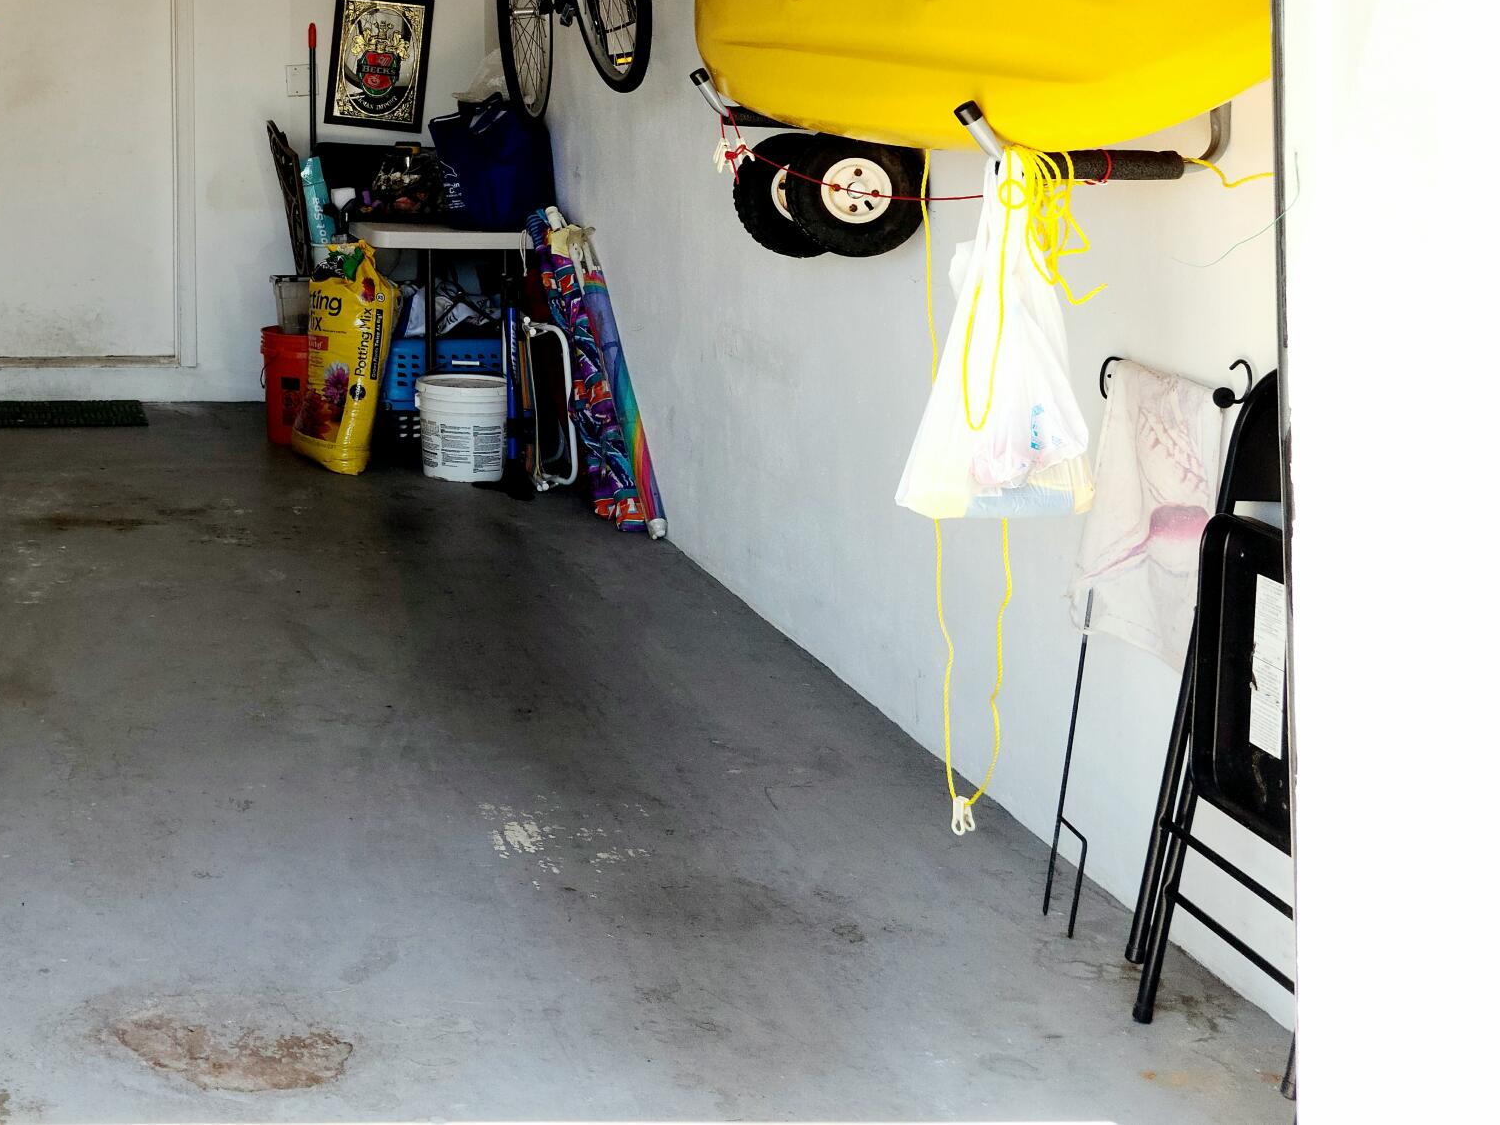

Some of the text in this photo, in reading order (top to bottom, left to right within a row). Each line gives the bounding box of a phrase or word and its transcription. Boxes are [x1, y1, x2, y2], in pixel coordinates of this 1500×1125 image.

[316, 223, 328, 244] oot
[359, 308, 372, 329] Mix
[355, 332, 372, 376] Potting
